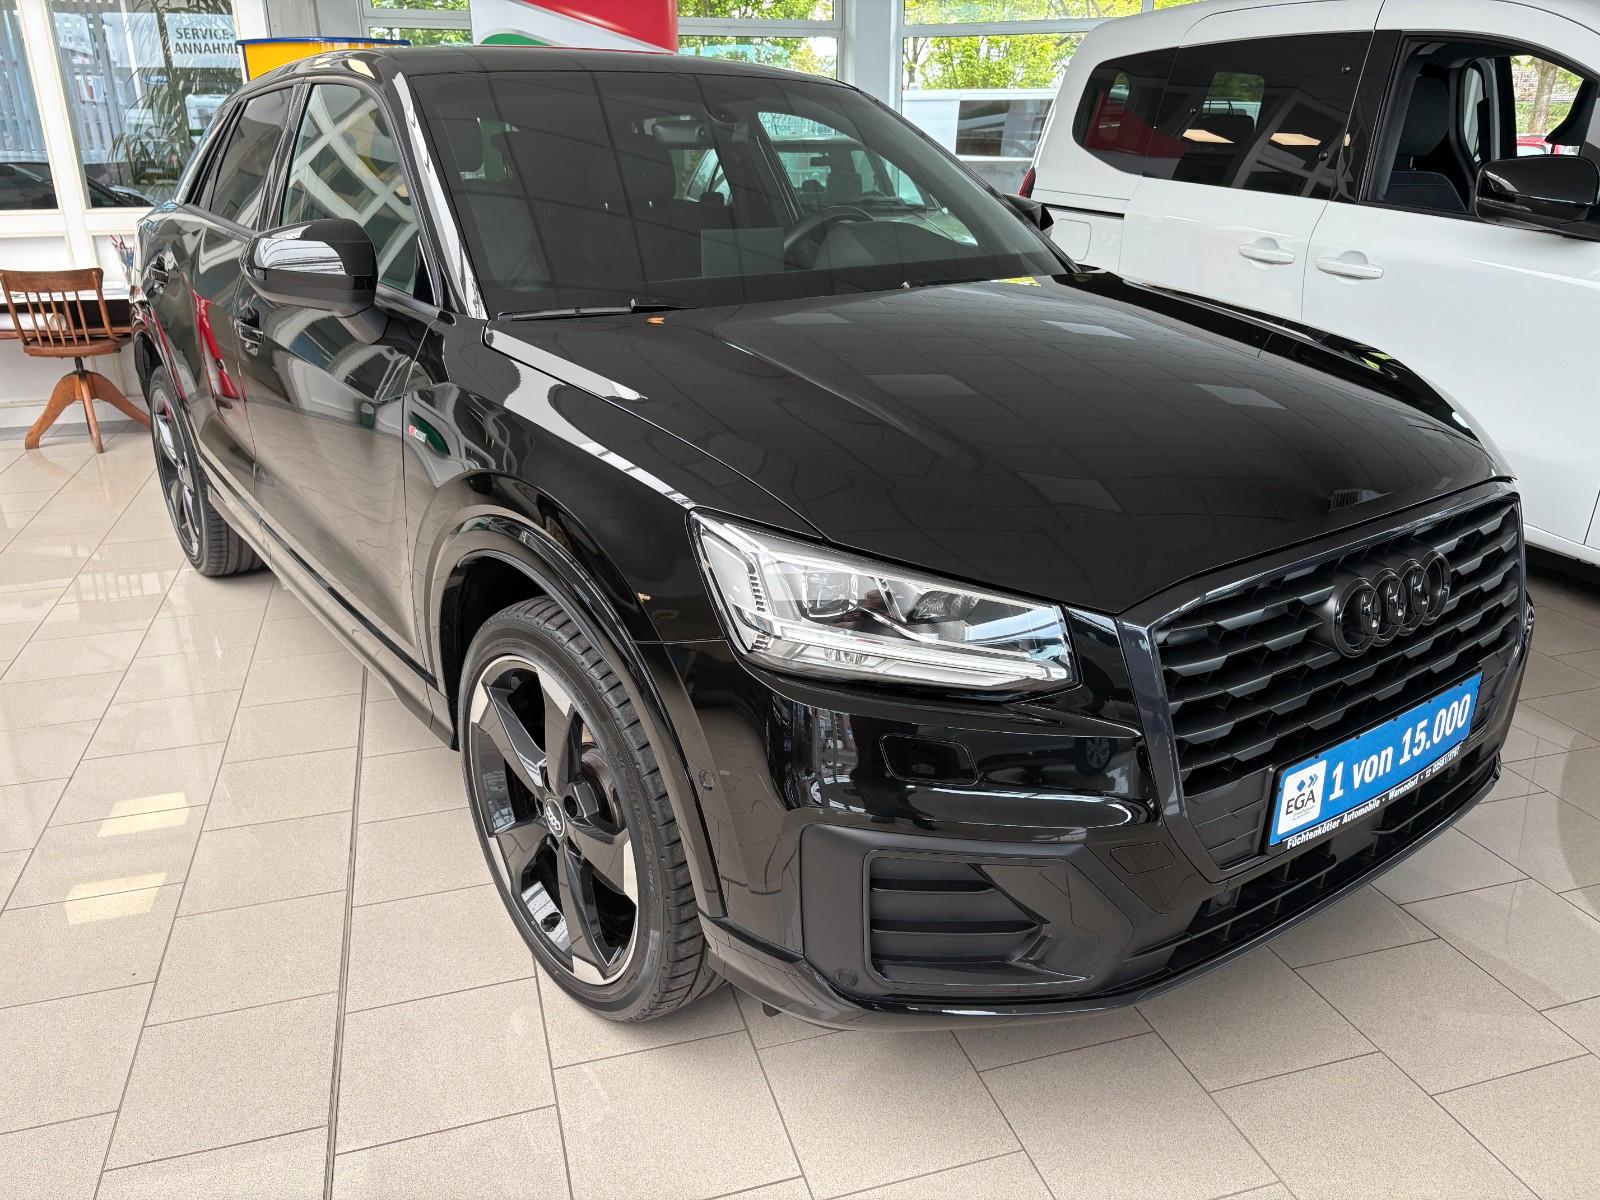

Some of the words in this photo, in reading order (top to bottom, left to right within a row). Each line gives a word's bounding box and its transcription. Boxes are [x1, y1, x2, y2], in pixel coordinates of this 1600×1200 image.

[175, 27, 235, 40] SERVICE-
[1329, 761, 1344, 801] 1
[1352, 745, 1394, 790] von
[1398, 692, 1472, 766] 15.000
[1285, 789, 1316, 816] EGA
[1286, 819, 1341, 850] Füchtenkötter
[1341, 799, 1381, 825] Automobile
[1388, 776, 1419, 801] Warendorf
